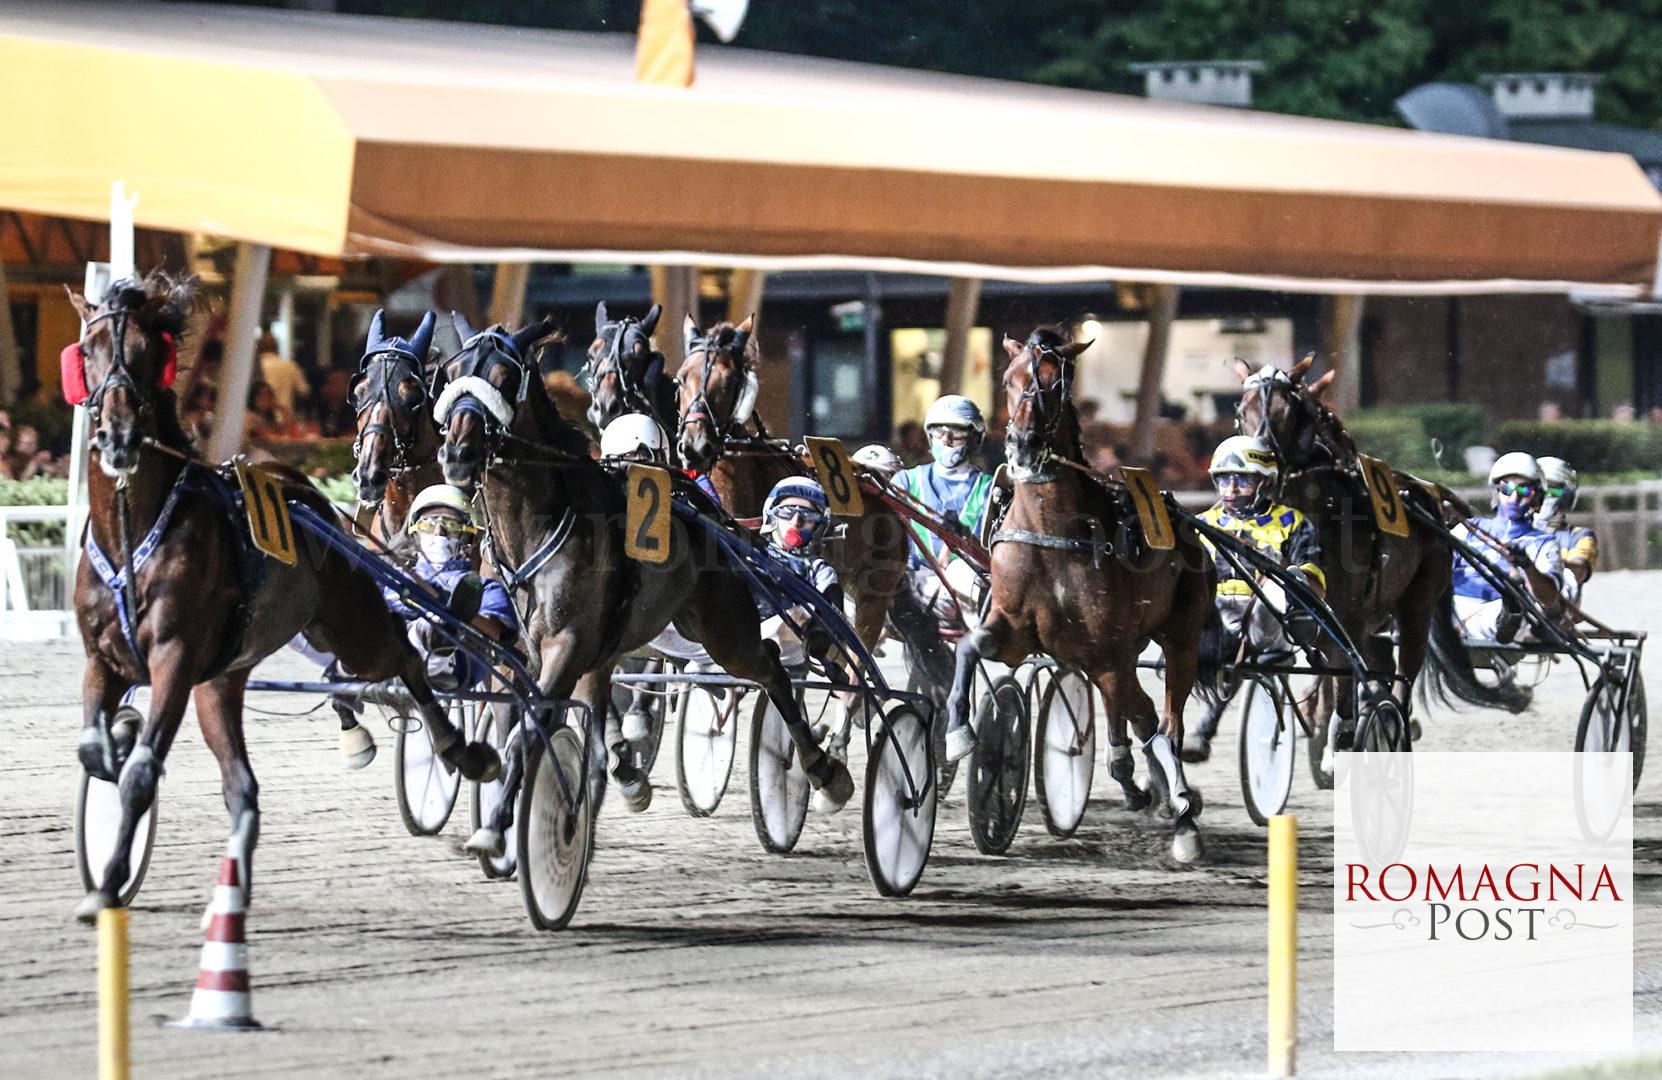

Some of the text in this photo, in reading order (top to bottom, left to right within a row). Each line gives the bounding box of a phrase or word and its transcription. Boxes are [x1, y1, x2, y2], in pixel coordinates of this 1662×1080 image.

[820, 446, 851, 504] 8
[1370, 465, 1397, 523] 9
[245, 470, 289, 552] 11
[635, 477, 660, 550] 2
[1135, 477, 1162, 538] 1
